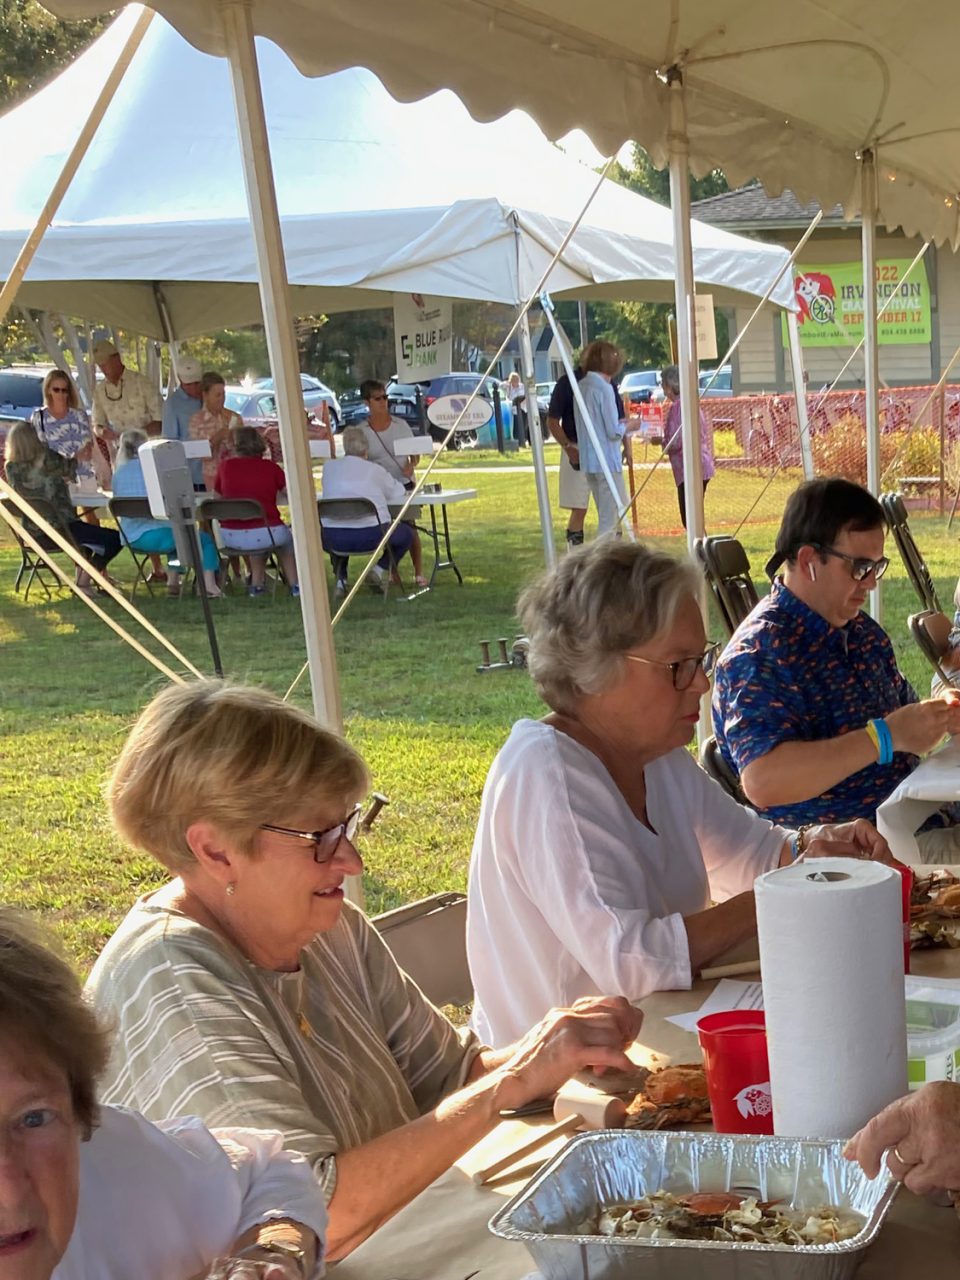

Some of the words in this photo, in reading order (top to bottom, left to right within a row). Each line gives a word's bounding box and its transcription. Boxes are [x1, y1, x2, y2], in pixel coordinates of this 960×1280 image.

[841, 283, 922, 300] IRVNGTON
[415, 330, 437, 349] BLUE
[415, 349, 438, 367] BANK
